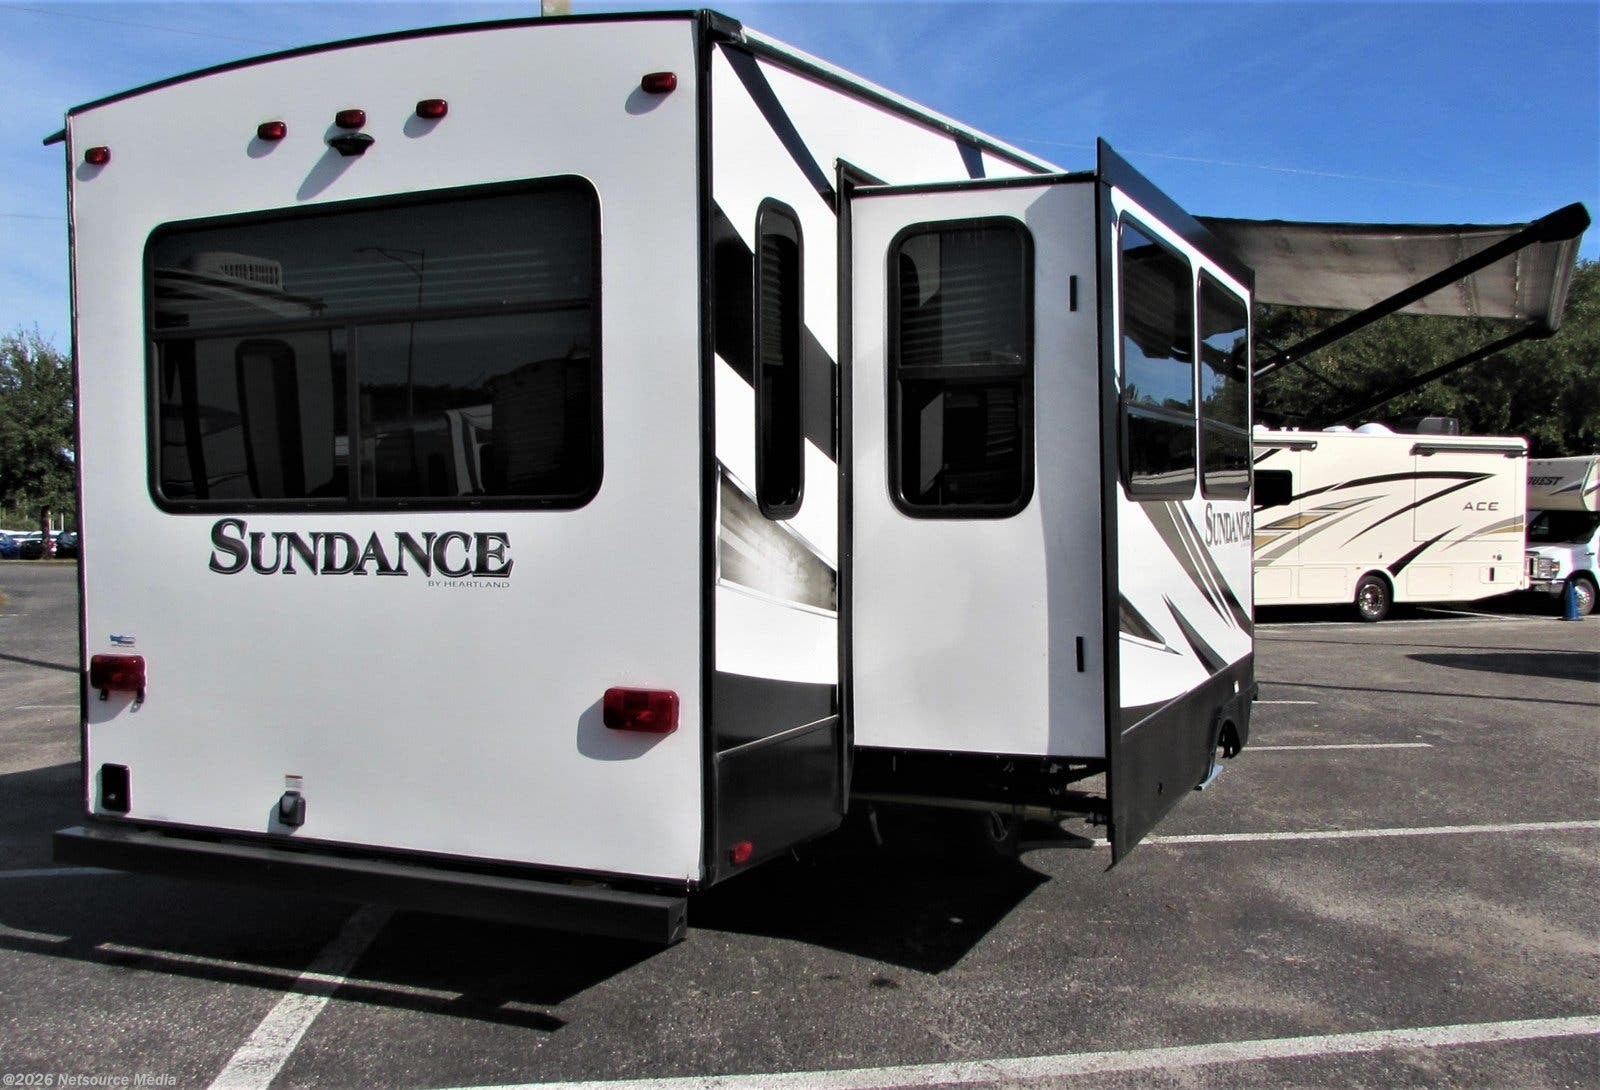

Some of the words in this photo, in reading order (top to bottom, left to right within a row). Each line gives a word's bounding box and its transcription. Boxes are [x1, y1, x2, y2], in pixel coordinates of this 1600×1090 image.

[1205, 502, 1250, 547] SUNDANCE
[1463, 502, 1499, 511] ACE
[209, 518, 514, 578] SUNDANCE
